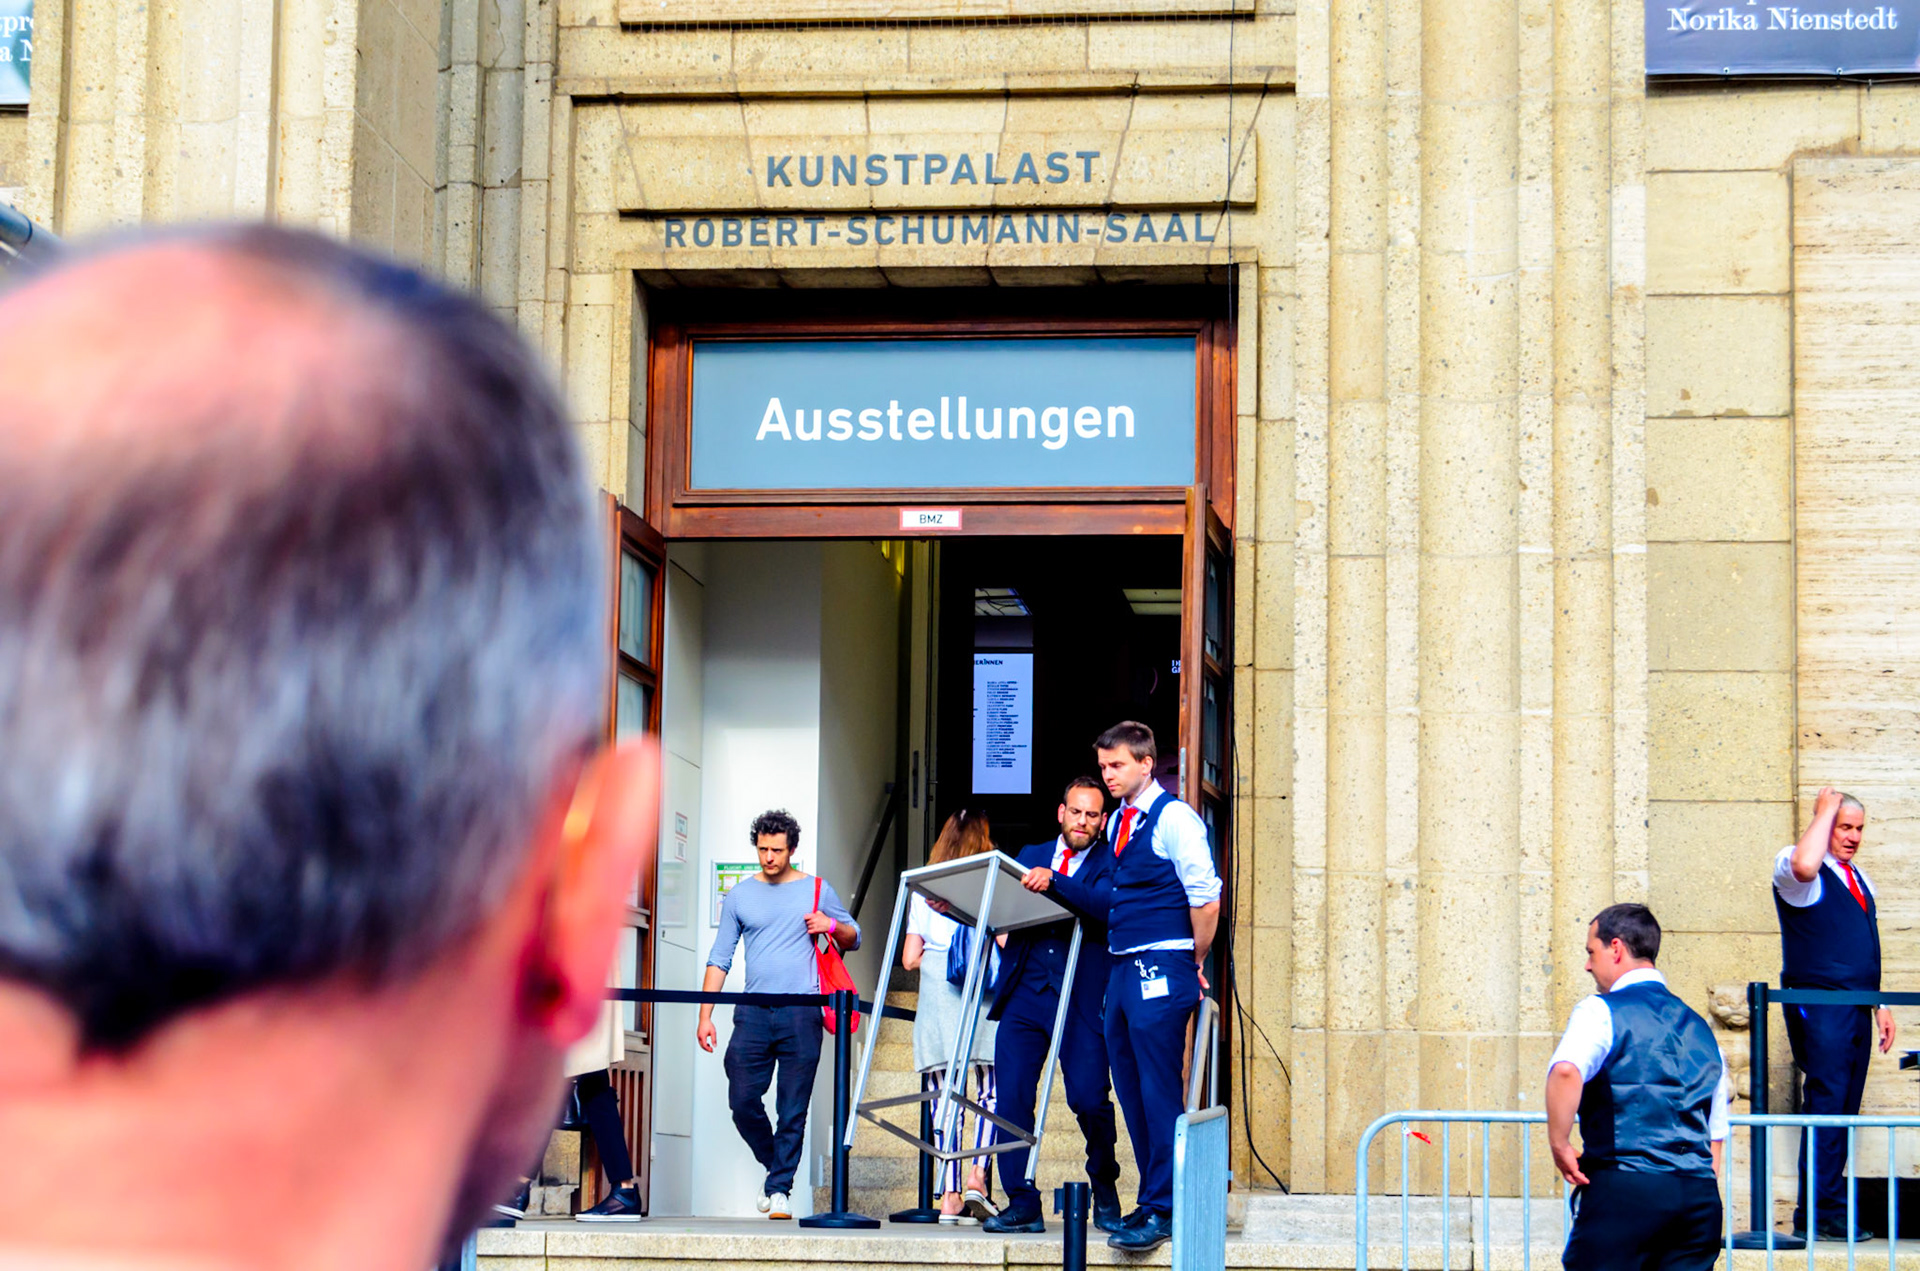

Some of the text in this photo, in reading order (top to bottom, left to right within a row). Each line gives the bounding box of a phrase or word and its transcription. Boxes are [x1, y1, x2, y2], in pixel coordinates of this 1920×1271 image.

[1667, 6, 1898, 31] Norika Nienstedt
[766, 151, 1101, 187] KUNSTPALAST
[665, 212, 1216, 248] ROBERT-SCHUMANN-SAAL
[756, 395, 1136, 450] Ausstellungen
[919, 513, 943, 524] BMZ
